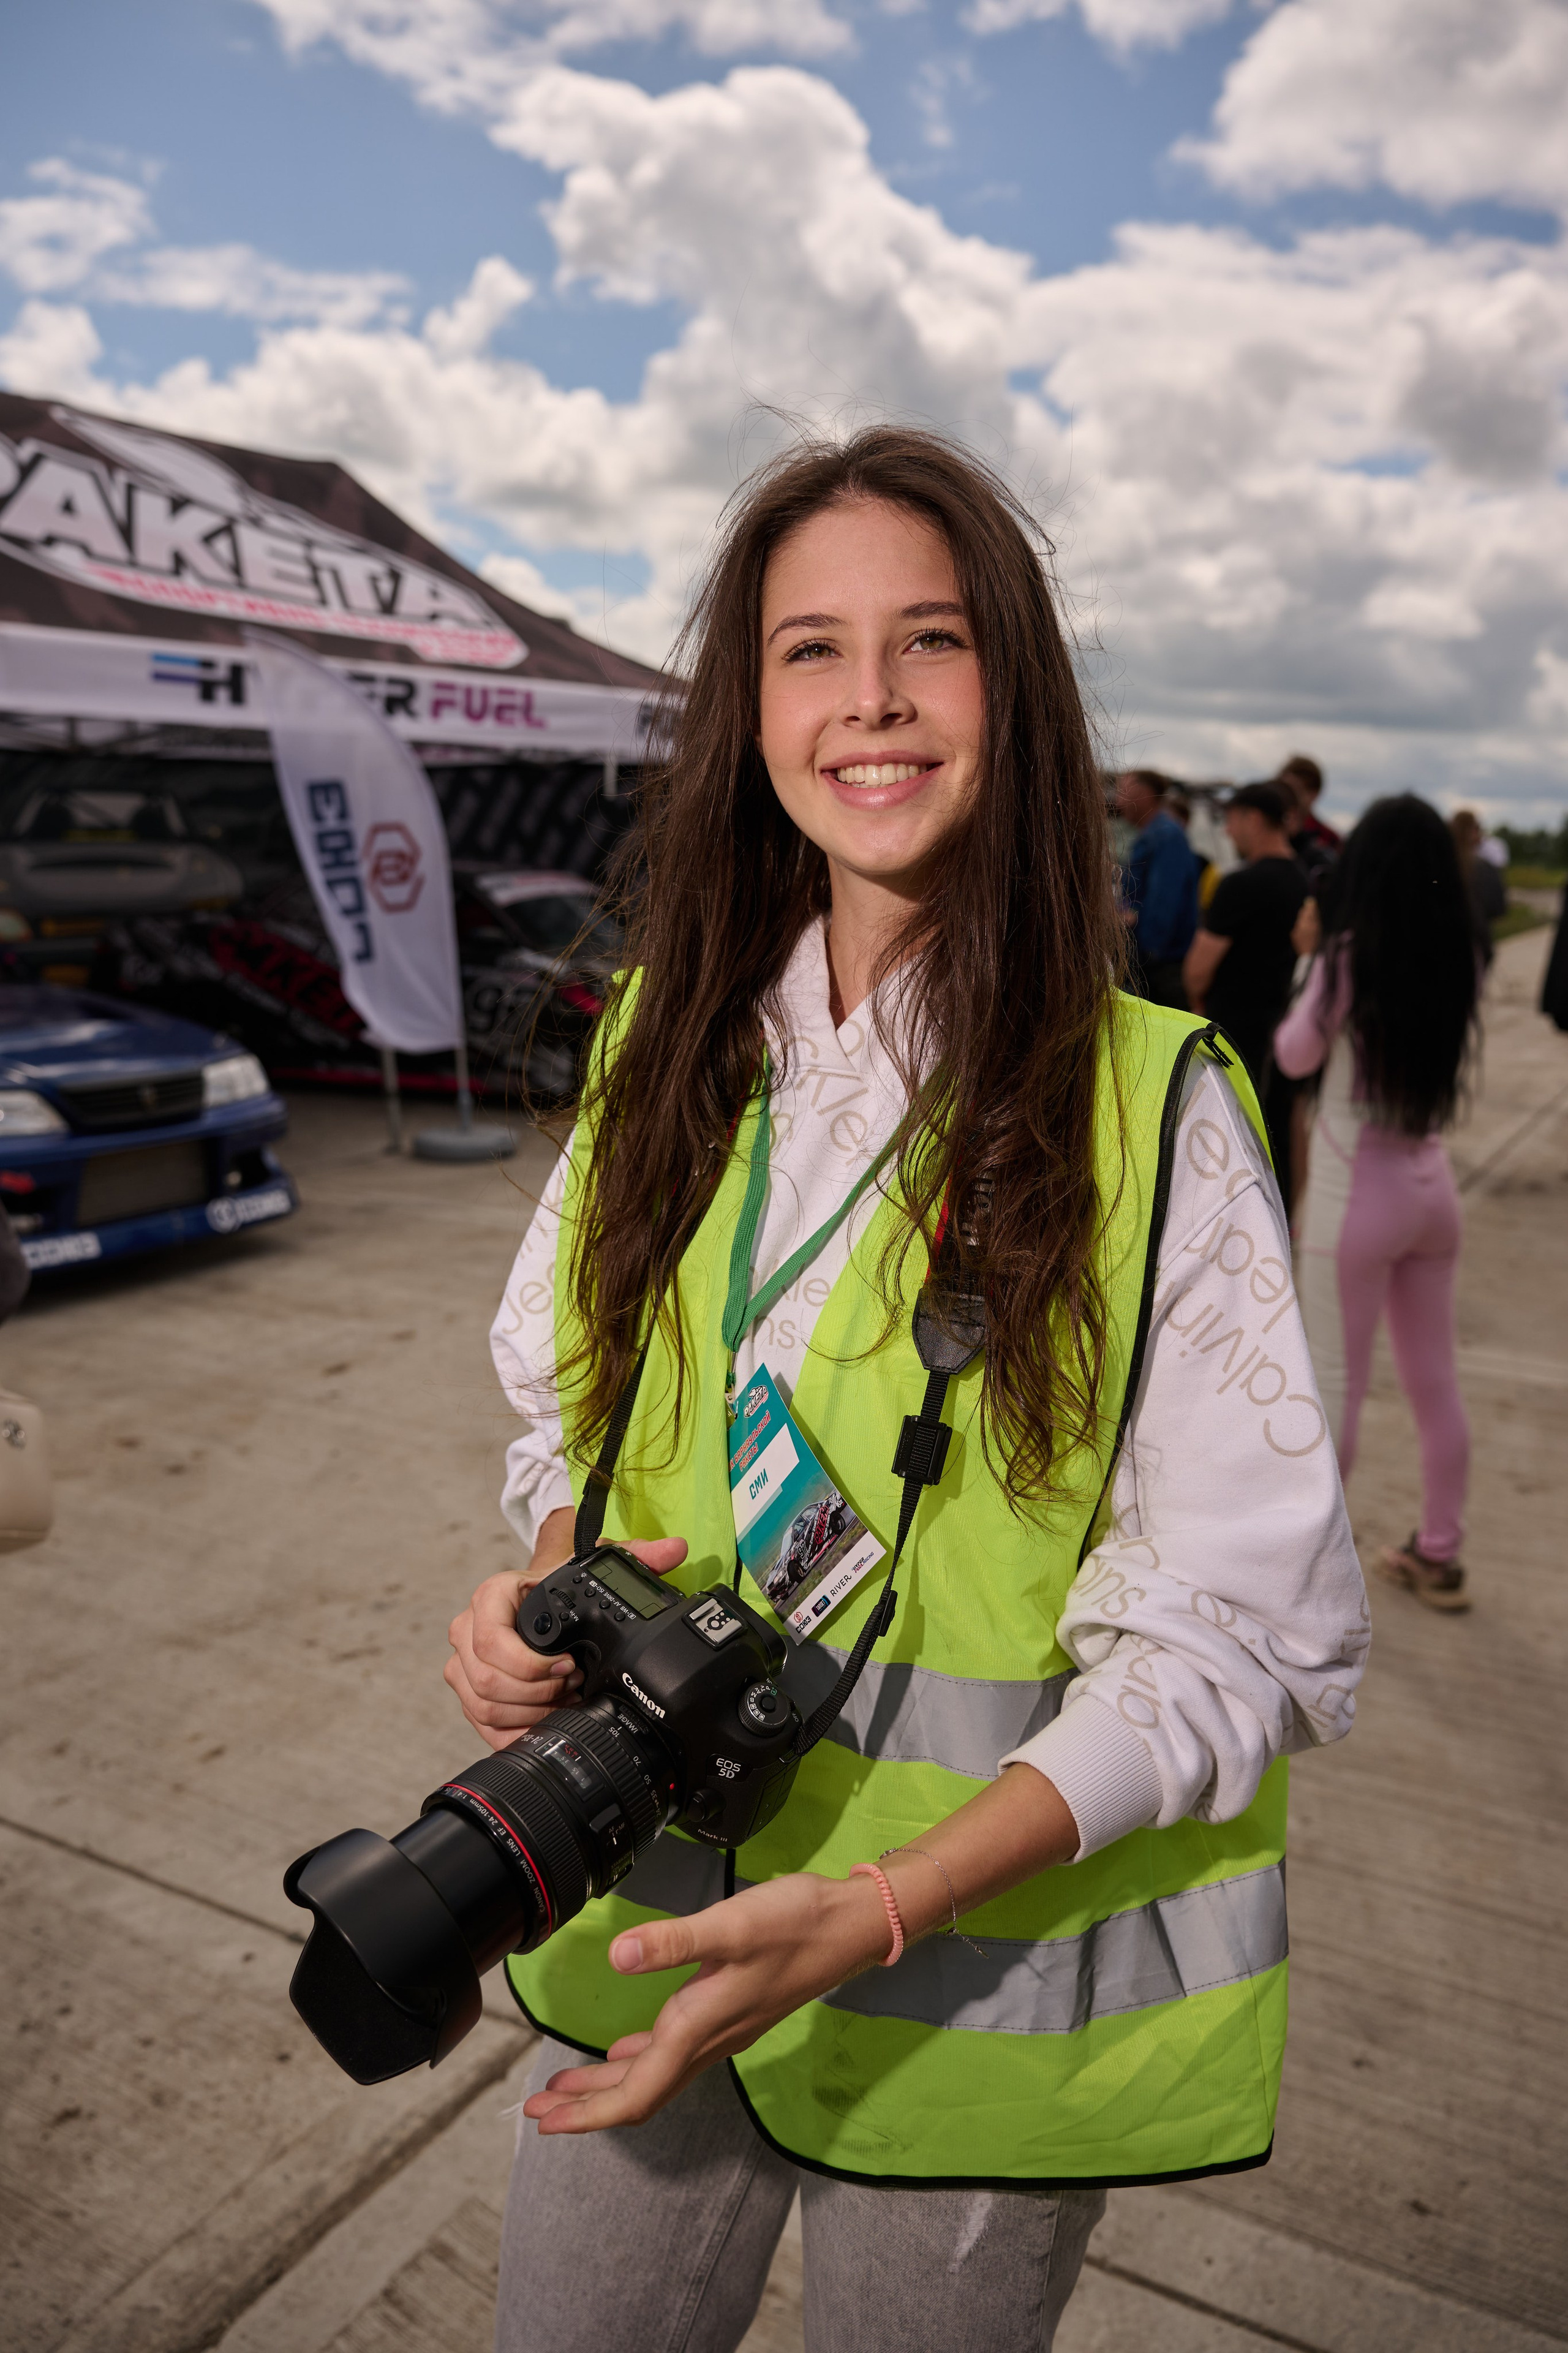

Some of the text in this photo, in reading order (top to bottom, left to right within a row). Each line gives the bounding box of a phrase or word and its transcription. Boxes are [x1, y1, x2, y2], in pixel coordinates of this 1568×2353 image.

[0, 432, 477, 625] АКЕТА
[431, 681, 546, 730] FUEL
[742, 1316, 796, 1350] ns
[744, 1385, 768, 1417] РАКЕТА
[734, 1410, 771, 1465] БАРНАУЛЬСКОЙ
[739, 1442, 759, 1472] РАКЕТЫ
[749, 1468, 769, 1500] СМИ
[830, 1574, 852, 1597] RIVER
[570, 1610, 579, 1622] M-Fn
[796, 1615, 812, 1634] СОЮЗ
[622, 1672, 666, 1719] Canon
[608, 1726, 620, 1737] 105
[617, 1713, 638, 1734] IMAGE
[633, 1756, 642, 1766] 70
[716, 1758, 741, 1772] EOS
[644, 1774, 652, 1785] 50
[718, 1768, 735, 1779] 5D
[650, 1789, 658, 1800] 35
[469, 1798, 499, 1826] 24-105mm
[497, 1827, 507, 1836] EF
[698, 1829, 718, 1840] Mark
[506, 1838, 521, 1857] LENS
[520, 1859, 536, 1884] ZOOM
[533, 1887, 545, 1913] CANON
